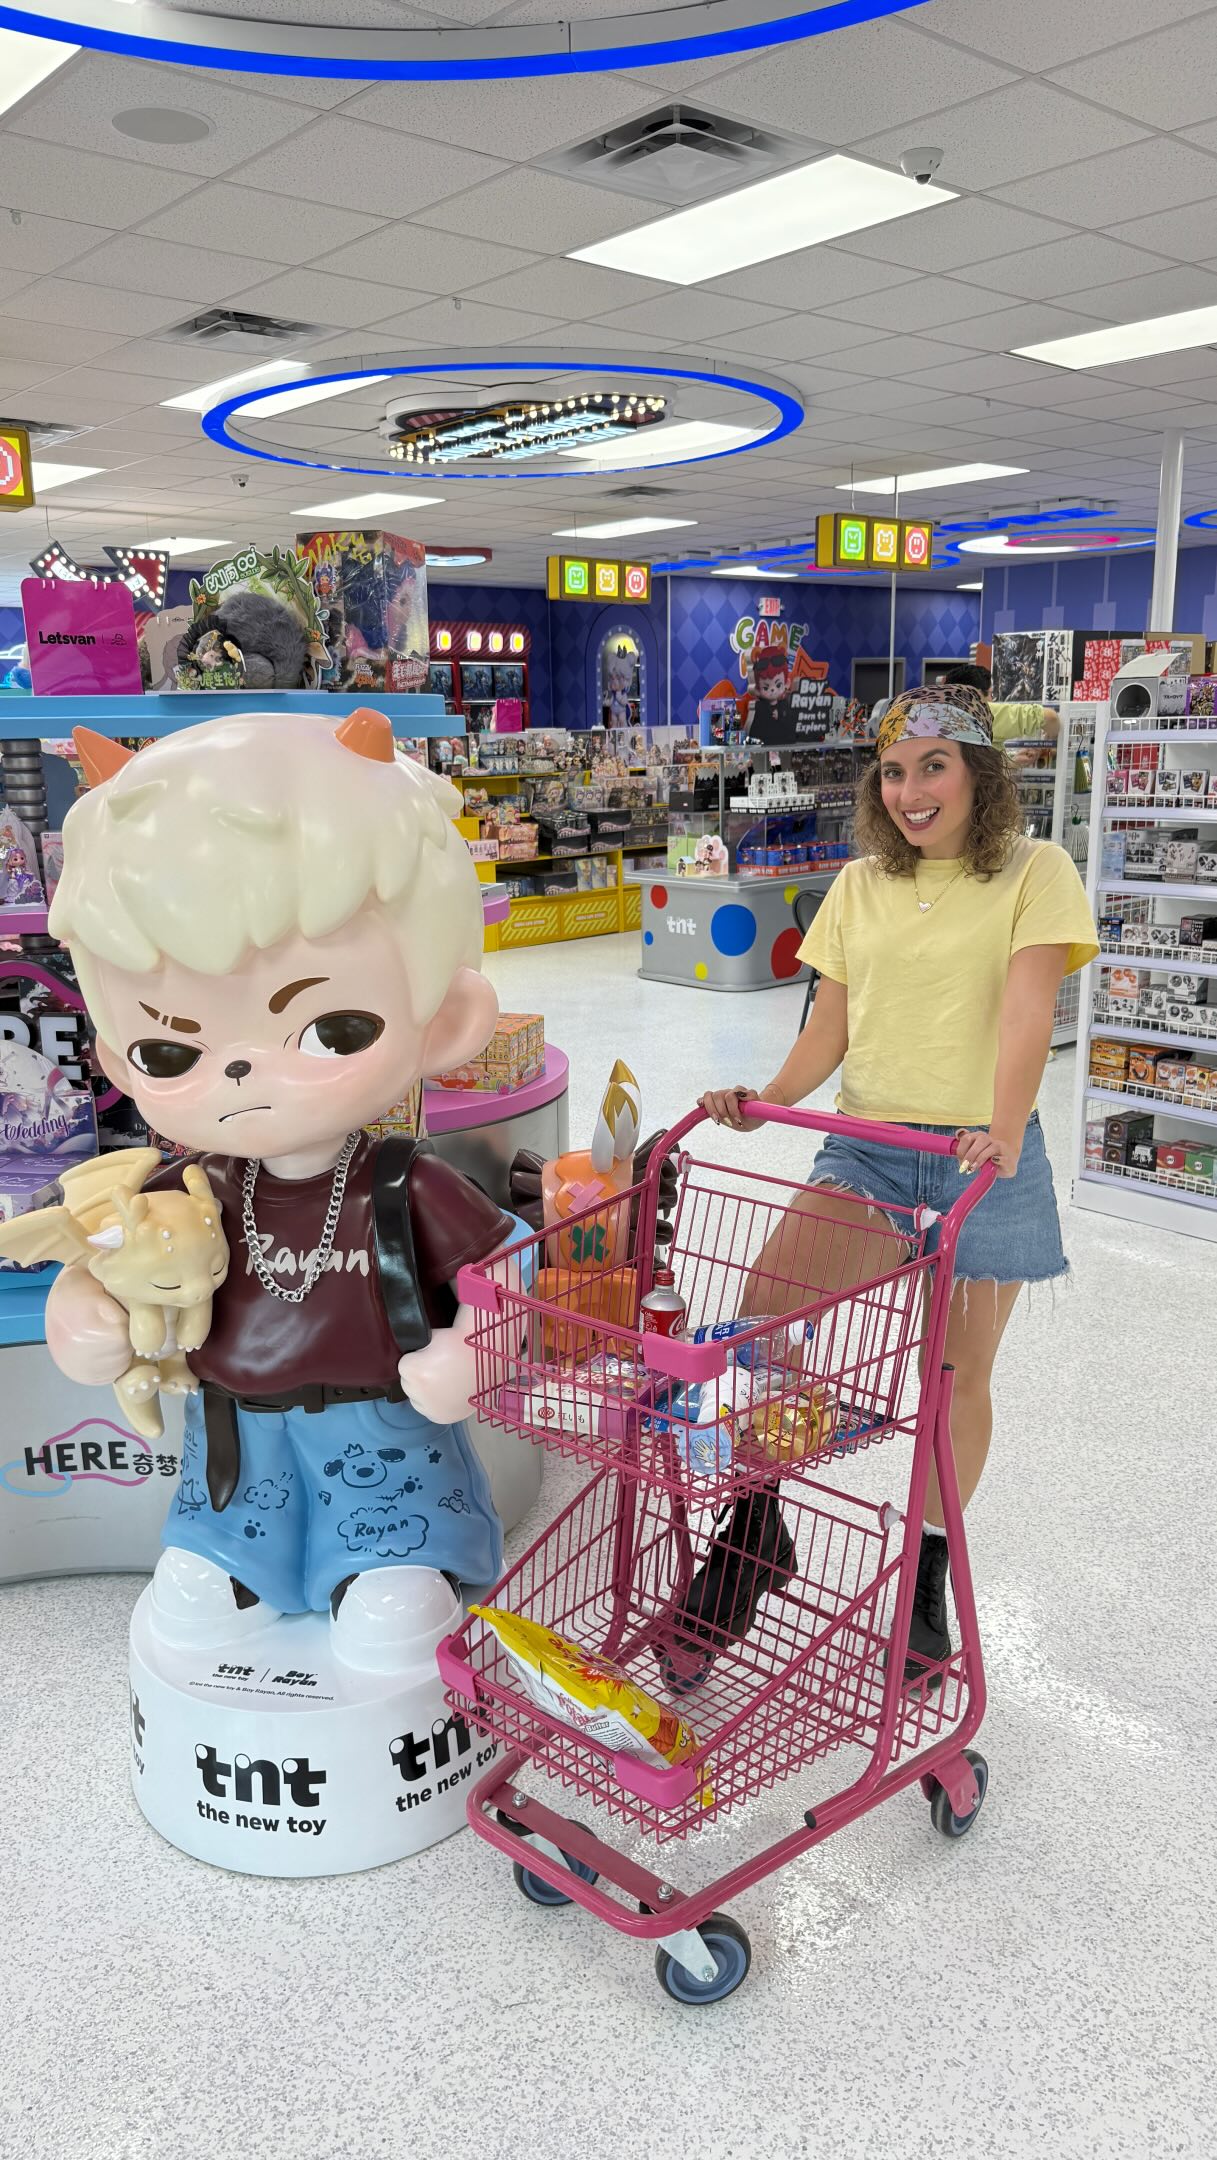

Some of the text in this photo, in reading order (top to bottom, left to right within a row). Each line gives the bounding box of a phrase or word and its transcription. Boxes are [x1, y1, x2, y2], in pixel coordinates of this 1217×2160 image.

[39, 631, 96, 645] Letsvan
[735, 617, 805, 651] GAME
[800, 679, 825, 697] Boy
[791, 693, 832, 711] Rayan
[817, 711, 827, 720] to
[796, 722, 827, 735] Explore
[666, 915, 697, 936] tnt
[1, 1114, 70, 1141] Wedding
[239, 1233, 370, 1286] Rayan
[24, 1441, 129, 1476] HERE
[132, 1452, 184, 1477] 奇梦
[354, 1519, 409, 1543] Rayan
[217, 1663, 256, 1677] tnt
[285, 1670, 314, 1679] Boy
[272, 1676, 318, 1687] Rayan
[286, 1691, 305, 1699] rights
[194, 1743, 327, 1808] tnt
[395, 1738, 499, 1813] the new toy
[196, 1799, 327, 1836] the new toy
